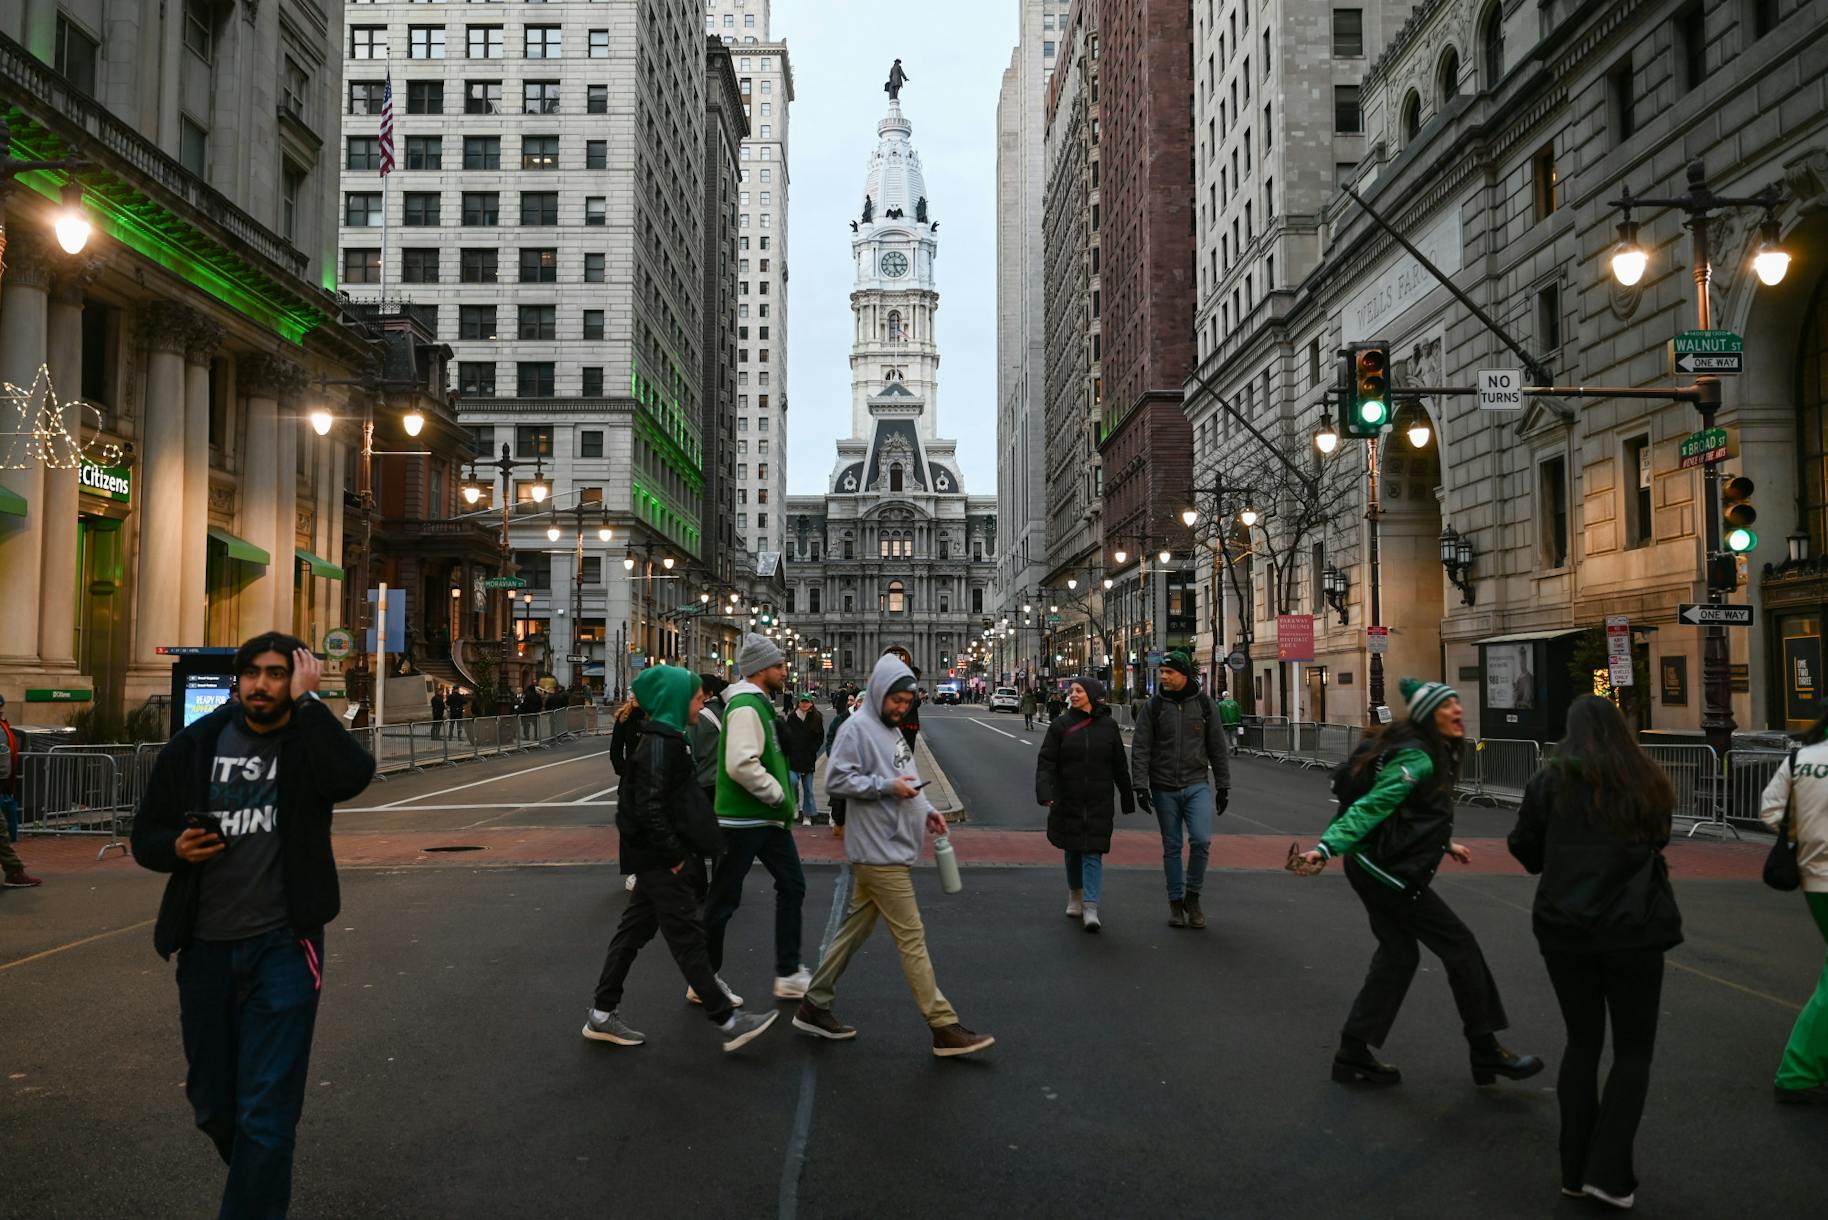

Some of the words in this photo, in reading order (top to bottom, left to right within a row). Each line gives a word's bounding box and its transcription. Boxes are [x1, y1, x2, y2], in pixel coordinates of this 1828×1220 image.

[1357, 285, 1392, 330] WELLS
[1676, 339, 1727, 351] WALNUT
[1731, 342, 1742, 351] ST
[1694, 358, 1713, 367] ONE
[1716, 358, 1736, 367] WAY
[1488, 375, 1511, 388] NO
[1481, 392, 1519, 403] TURNS
[1688, 435, 1717, 456] BROAD
[1718, 436, 1726, 447] ST
[82, 465, 129, 494] Citizens
[485, 580, 517, 588] MORAVIAN
[1700, 610, 1721, 620] ONE
[1724, 610, 1746, 620] WAY
[196, 695, 215, 704] READY
[211, 756, 262, 783] IT'S
[208, 805, 278, 836] HIN
